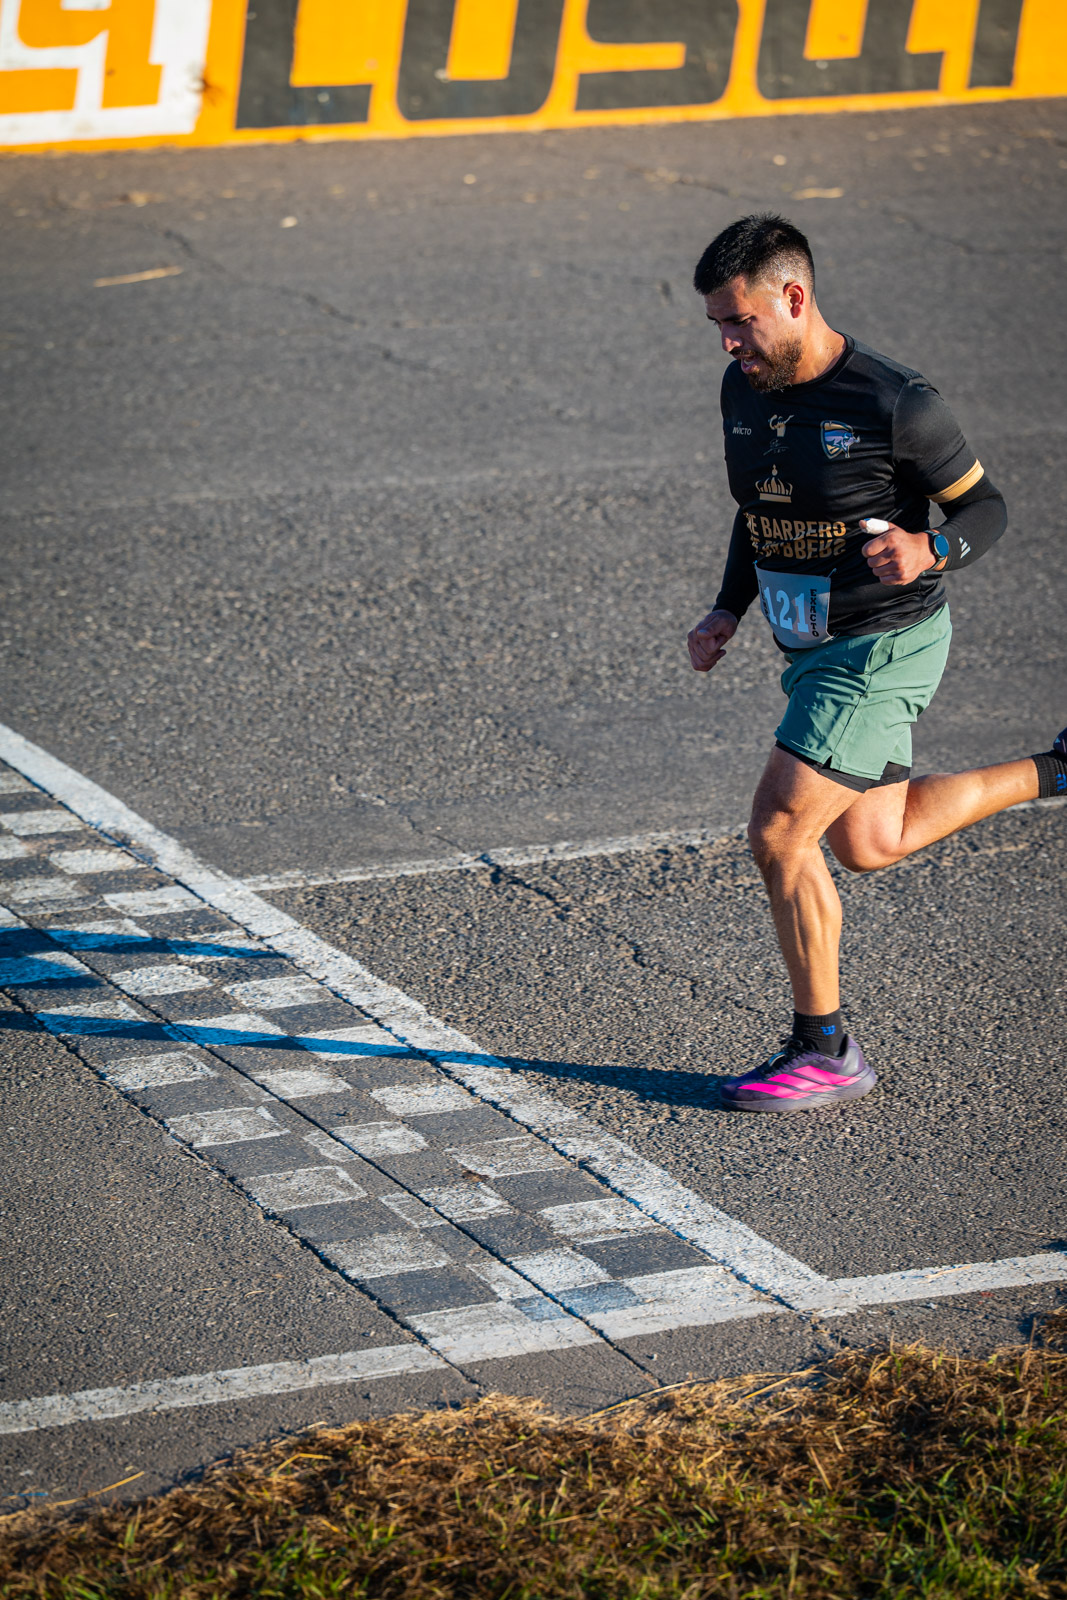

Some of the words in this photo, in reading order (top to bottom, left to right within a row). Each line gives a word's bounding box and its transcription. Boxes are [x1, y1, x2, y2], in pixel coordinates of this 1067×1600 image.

[759, 515, 847, 541] BARBERS
[763, 586, 810, 634] 121
[809, 588, 820, 638] EXACTO
